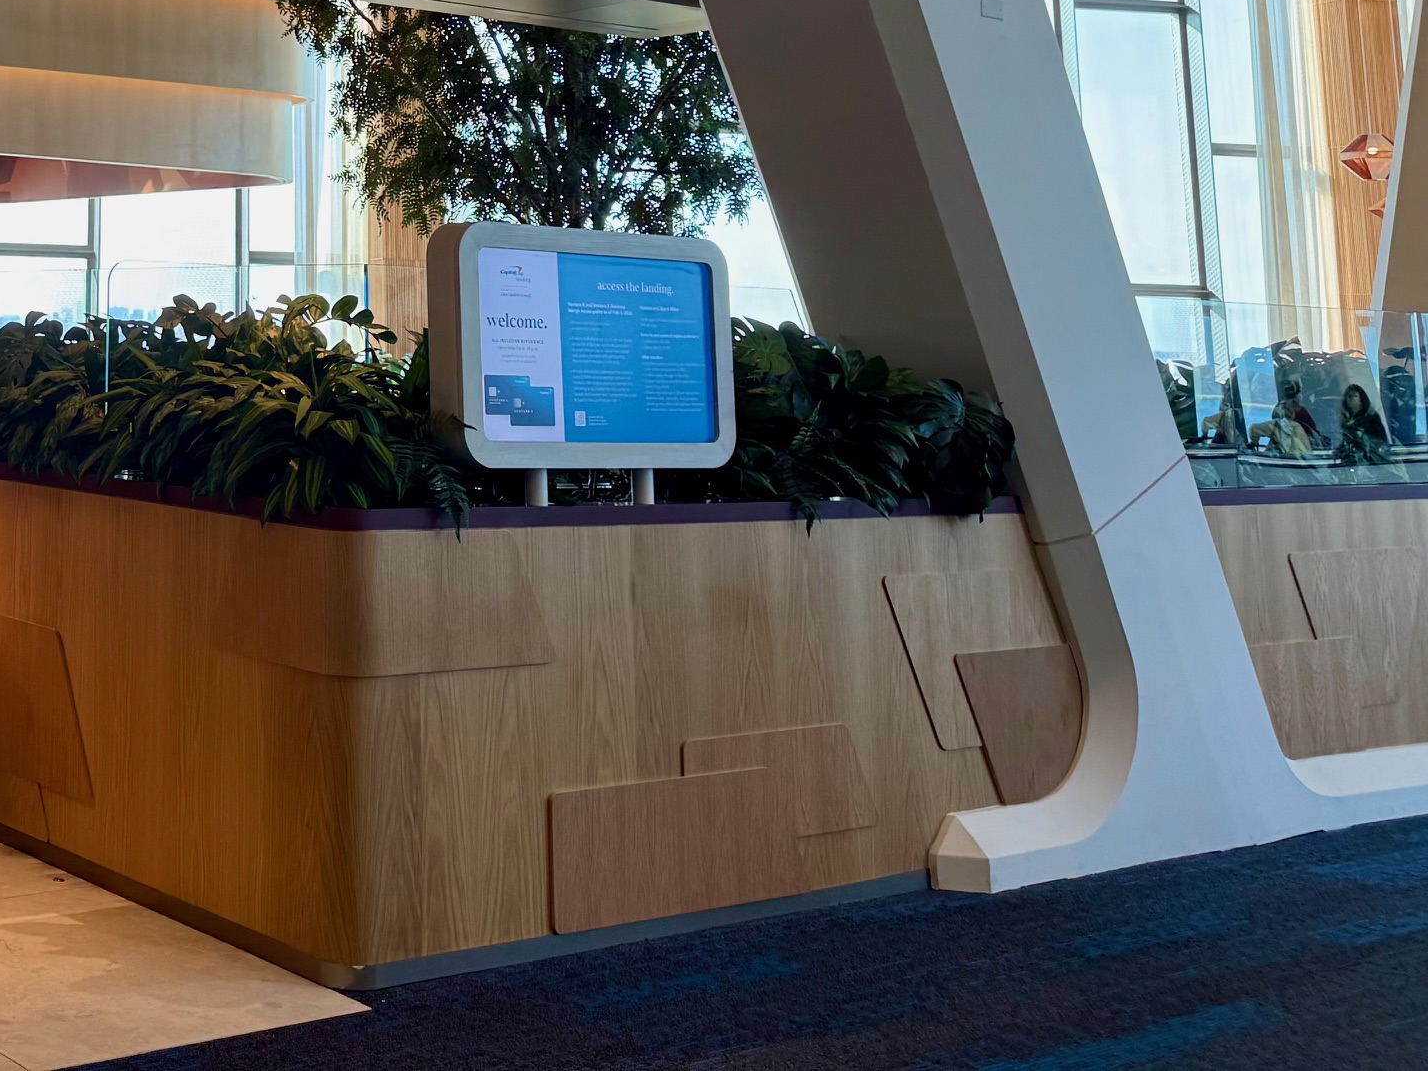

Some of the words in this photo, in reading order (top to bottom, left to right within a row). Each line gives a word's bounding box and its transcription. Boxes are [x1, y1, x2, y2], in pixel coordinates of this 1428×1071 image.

[597, 282, 624, 291] access
[626, 281, 640, 292] the
[641, 282, 674, 296] landing.
[486, 312, 547, 329] welcome.
